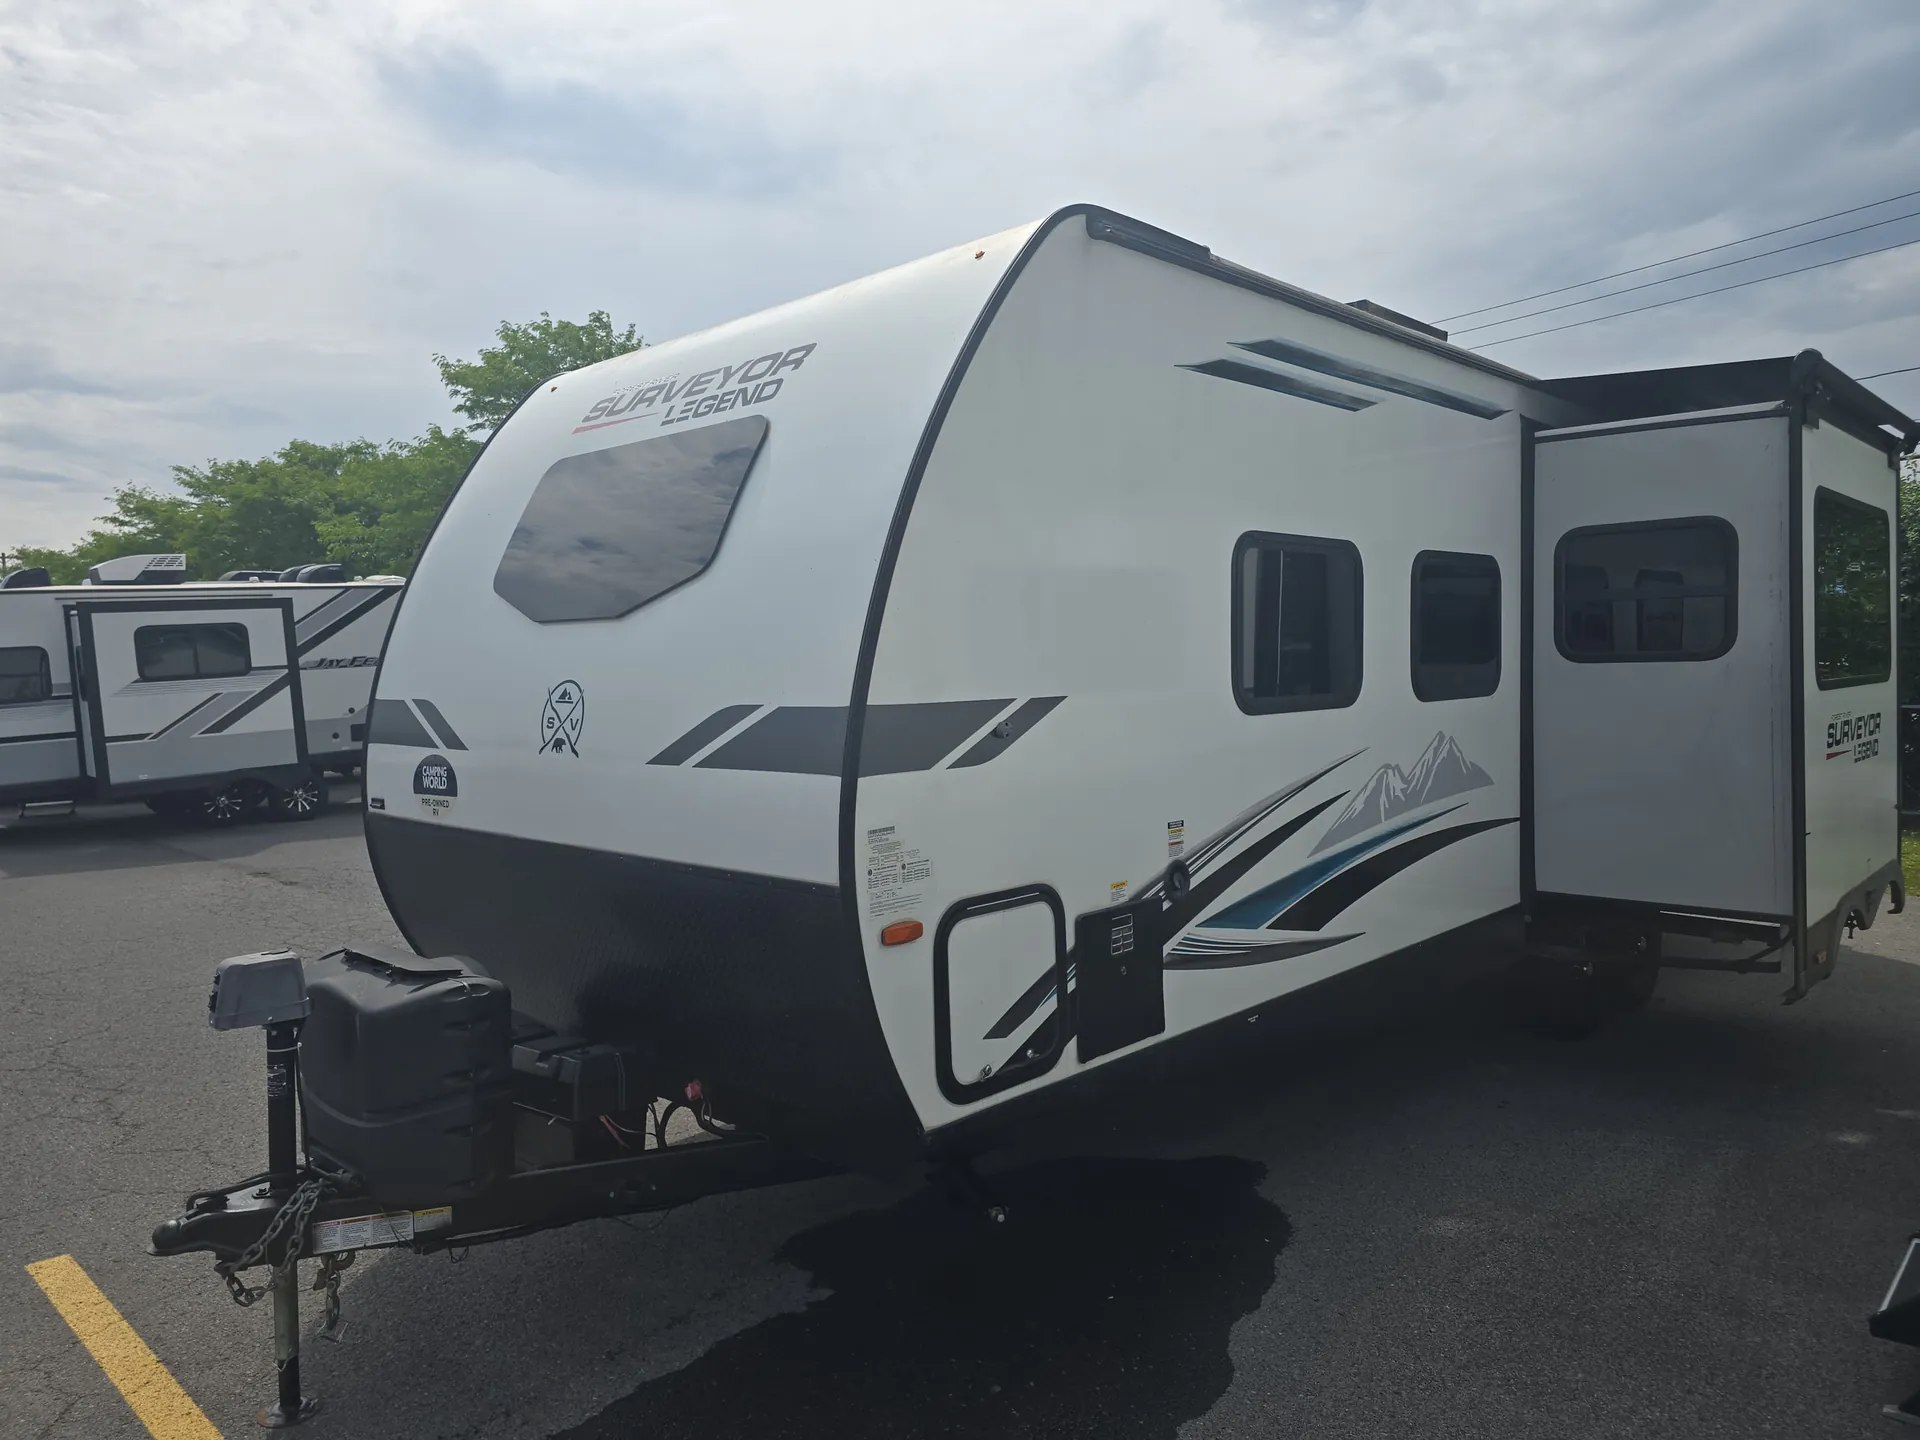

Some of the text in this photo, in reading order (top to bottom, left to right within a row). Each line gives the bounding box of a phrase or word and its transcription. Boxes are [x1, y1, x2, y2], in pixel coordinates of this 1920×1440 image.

[582, 343, 817, 423] SURVEYOR
[660, 378, 784, 427] LEGEND
[546, 717, 580, 731] S V
[1827, 712, 1881, 749] SURVEYOR
[1854, 739, 1879, 763] LEGEND
[422, 765, 447, 777] CAMPING
[422, 776, 447, 789] WORLD
[421, 798, 450, 808] PRE-OWNED
[432, 808, 439, 816] RV
